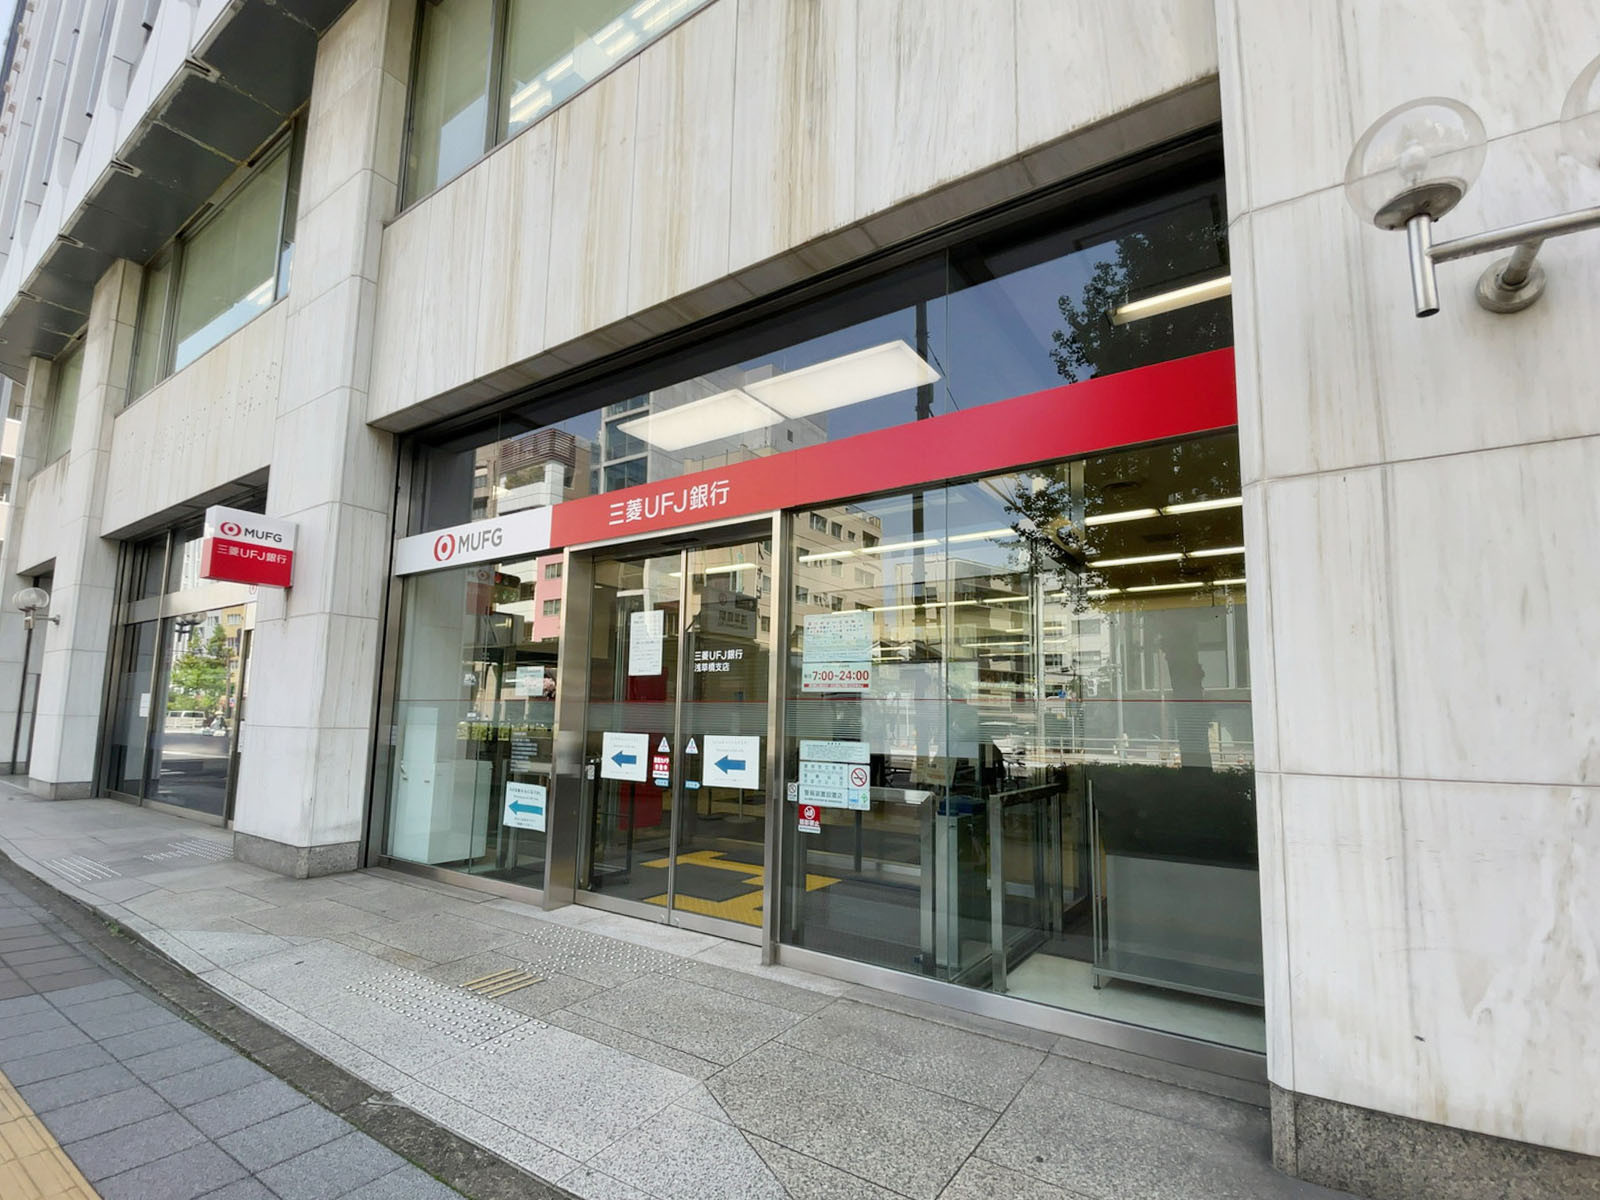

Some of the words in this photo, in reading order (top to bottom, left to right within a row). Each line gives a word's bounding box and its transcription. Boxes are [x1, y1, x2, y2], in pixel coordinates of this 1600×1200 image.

[608, 479, 731, 526] 三菱UFJ銀行
[244, 527, 283, 543] MUFG
[458, 528, 503, 554] MUFG
[217, 543, 288, 565] 三菱UFJ銀行
[694, 648, 744, 661] 三菱UFJ銀行
